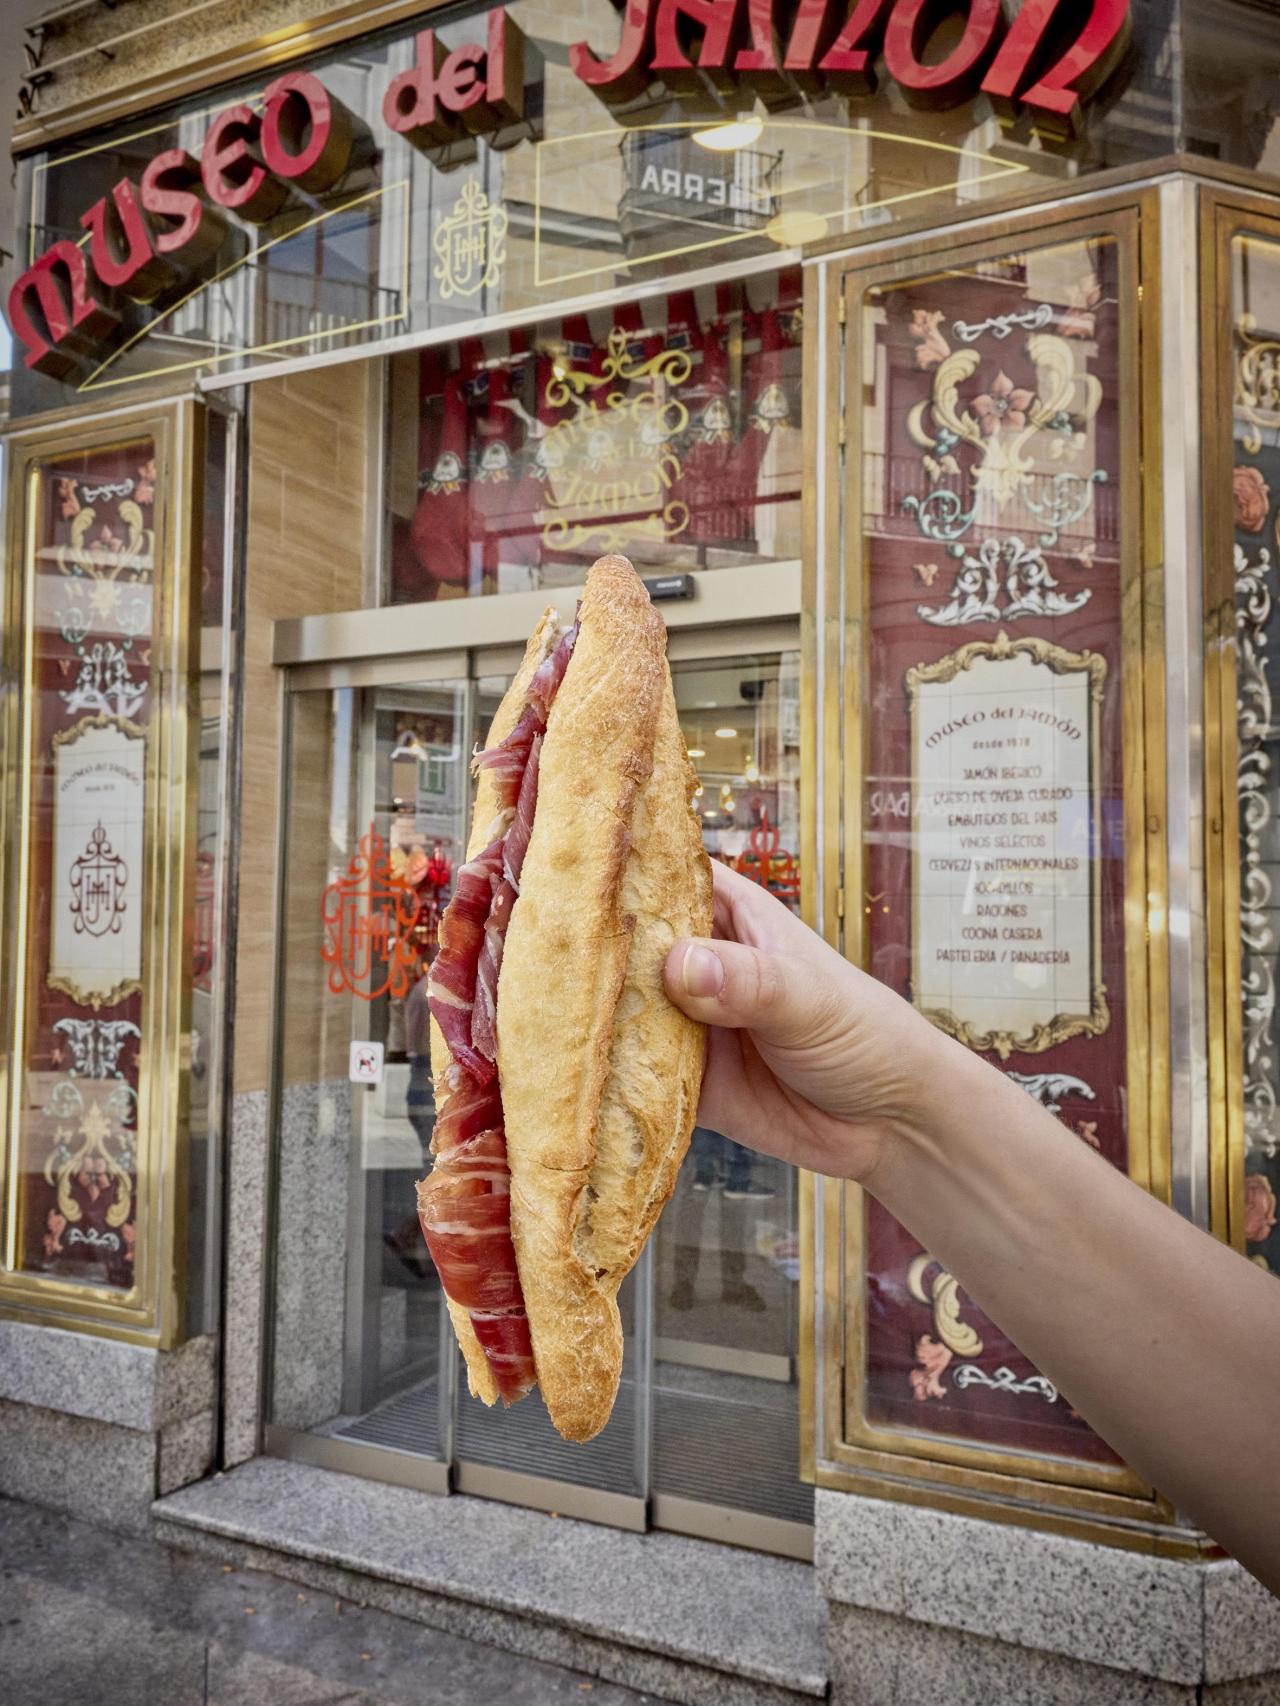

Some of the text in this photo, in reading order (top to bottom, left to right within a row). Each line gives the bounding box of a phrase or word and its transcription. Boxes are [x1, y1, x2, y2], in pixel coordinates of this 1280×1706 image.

[8, 71, 333, 368] MUSEO
[382, 8, 506, 133] del
[990, 707, 1014, 720] del
[972, 739, 1003, 749] desde
[973, 790, 988, 803] DE
[990, 789, 1024, 802] OVEJA
[1028, 787, 1073, 801] CURADO
[948, 812, 1008, 827] EMBUTIDOS
[1011, 812, 1030, 825] DEL
[960, 835, 1046, 849] VINOS SELECTOS
[984, 857, 1079, 871] INTERNACIONALES
[976, 904, 1028, 917] RACIONES
[961, 927, 1043, 940] COCINA CASERA
